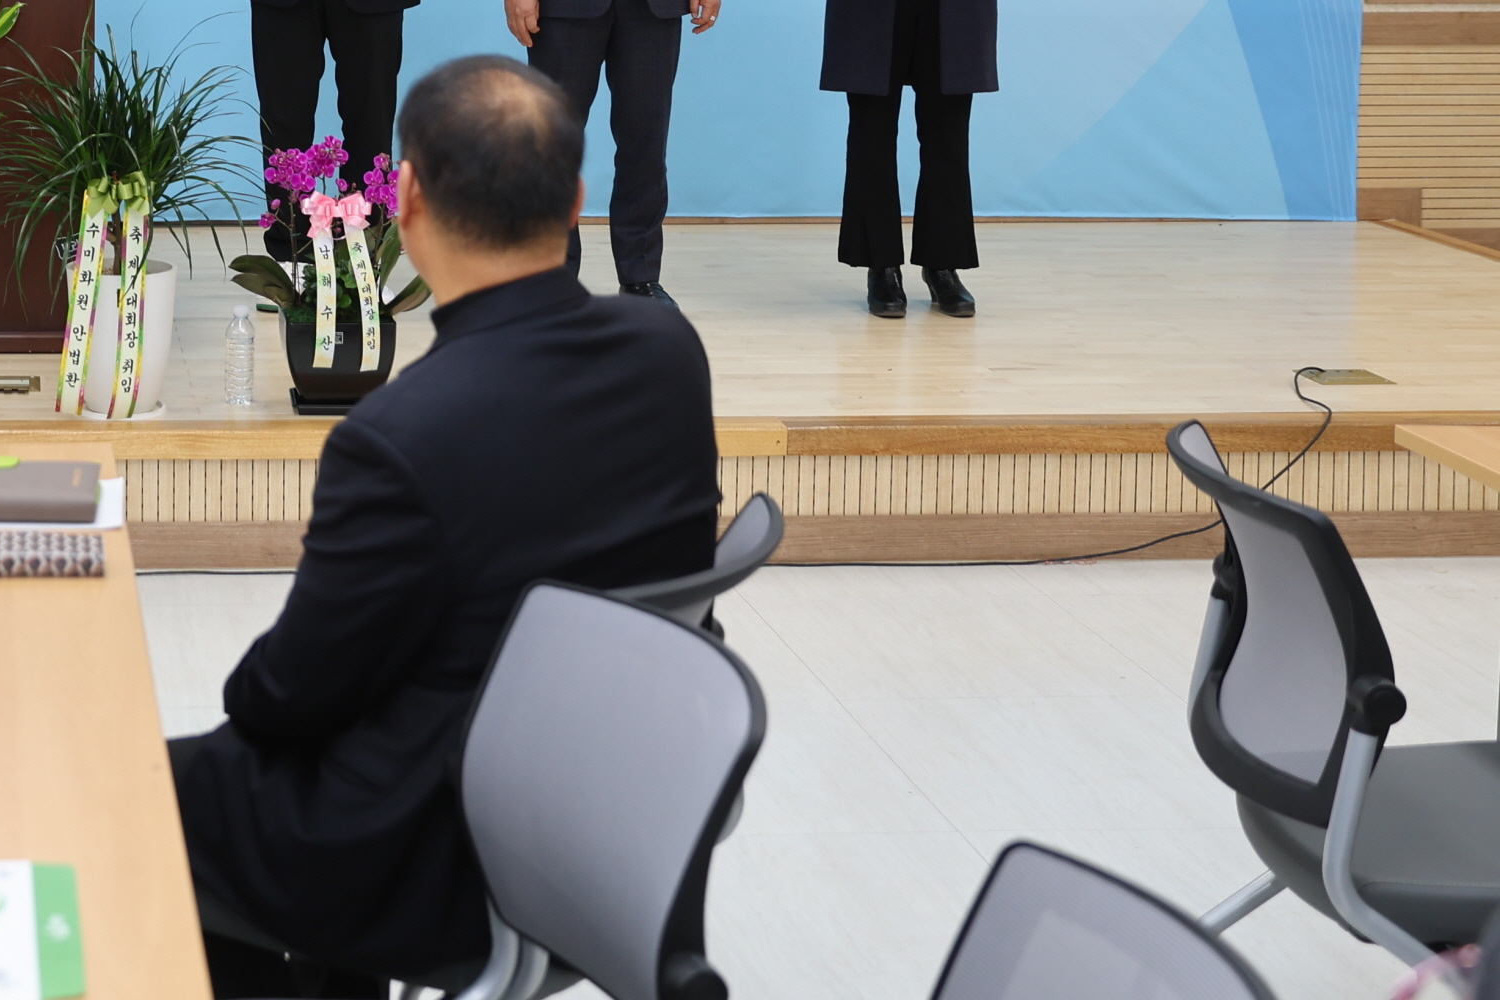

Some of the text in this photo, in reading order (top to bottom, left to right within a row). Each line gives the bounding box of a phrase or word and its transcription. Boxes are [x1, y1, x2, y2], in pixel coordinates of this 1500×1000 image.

[77, 222, 101, 311] 수미화원
[129, 226, 142, 245] 축
[352, 241, 377, 350] 축 제7대회장 취임
[120, 358, 135, 393] 취임
